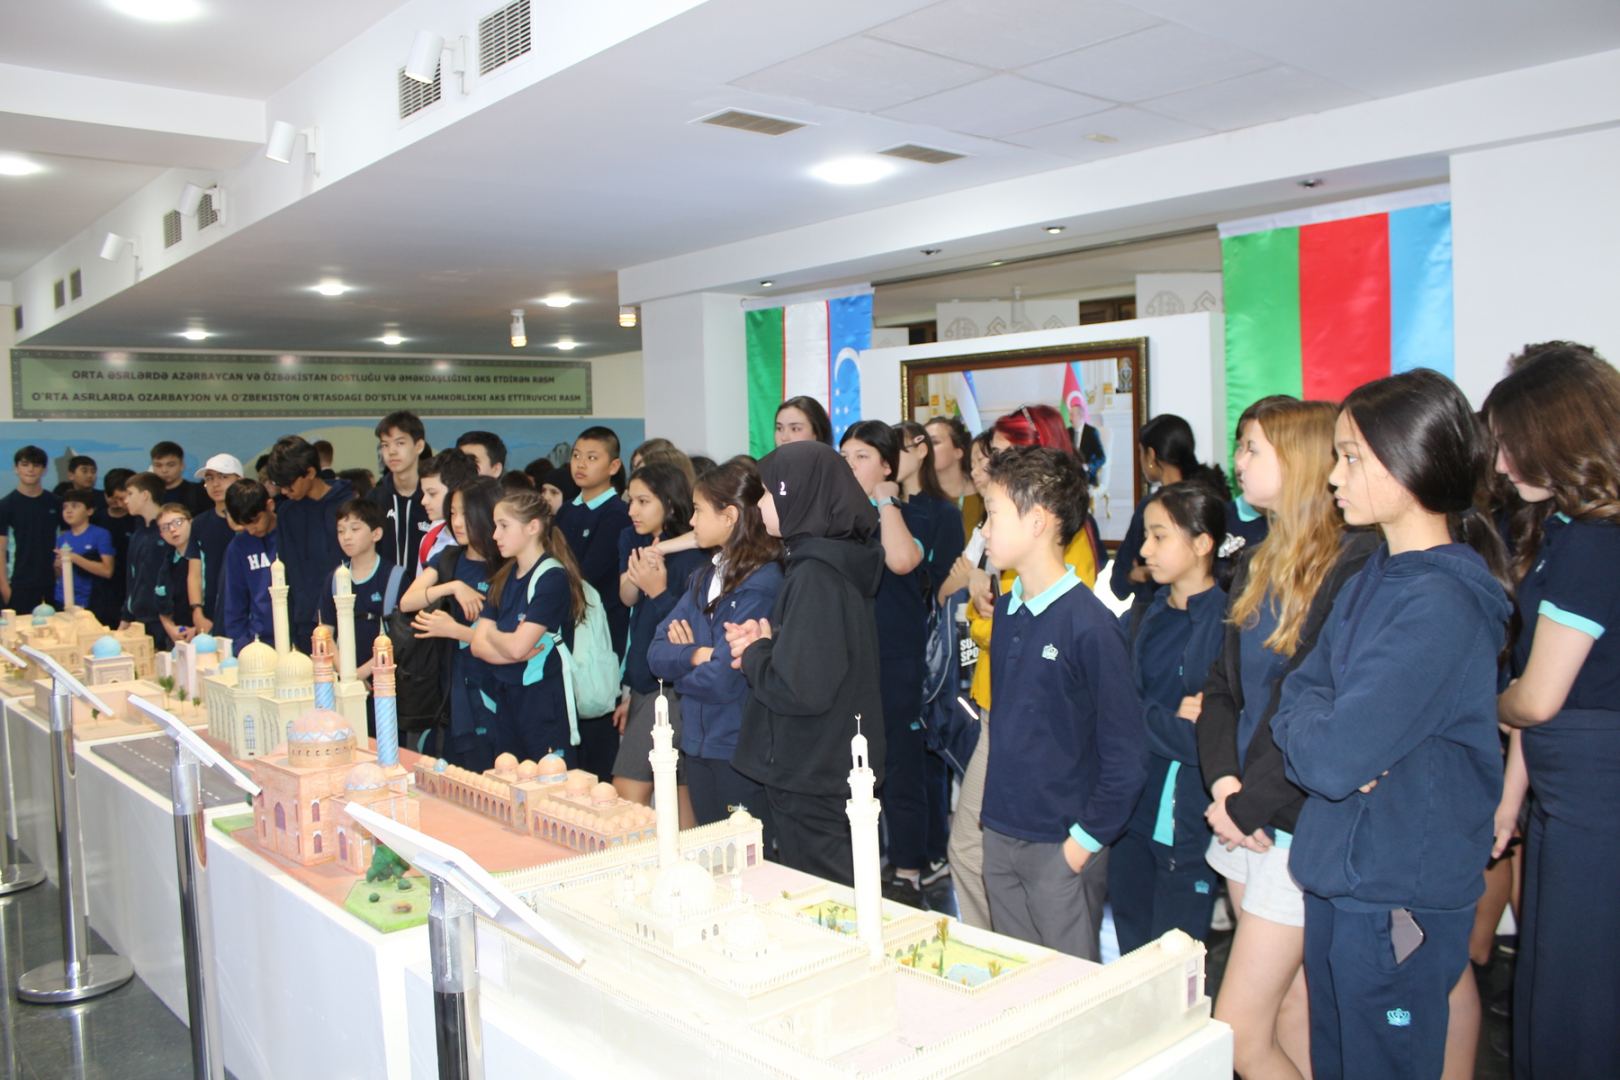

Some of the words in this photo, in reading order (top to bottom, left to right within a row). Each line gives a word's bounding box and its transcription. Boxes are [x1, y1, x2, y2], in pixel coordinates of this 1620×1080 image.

[72, 370, 104, 379] ORTA
[172, 372, 244, 381] AZƏRBAYCAN
[246, 372, 261, 381] VƏ
[383, 374, 396, 382] VƏ
[72, 393, 134, 402] ASRLARDA
[137, 393, 211, 402] OZARBAYJON
[215, 393, 229, 402] VA
[410, 393, 422, 402] VA
[424, 393, 487, 402] HAMKORLIKNI
[489, 393, 506, 402] AKS
[559, 394, 582, 402] RASM
